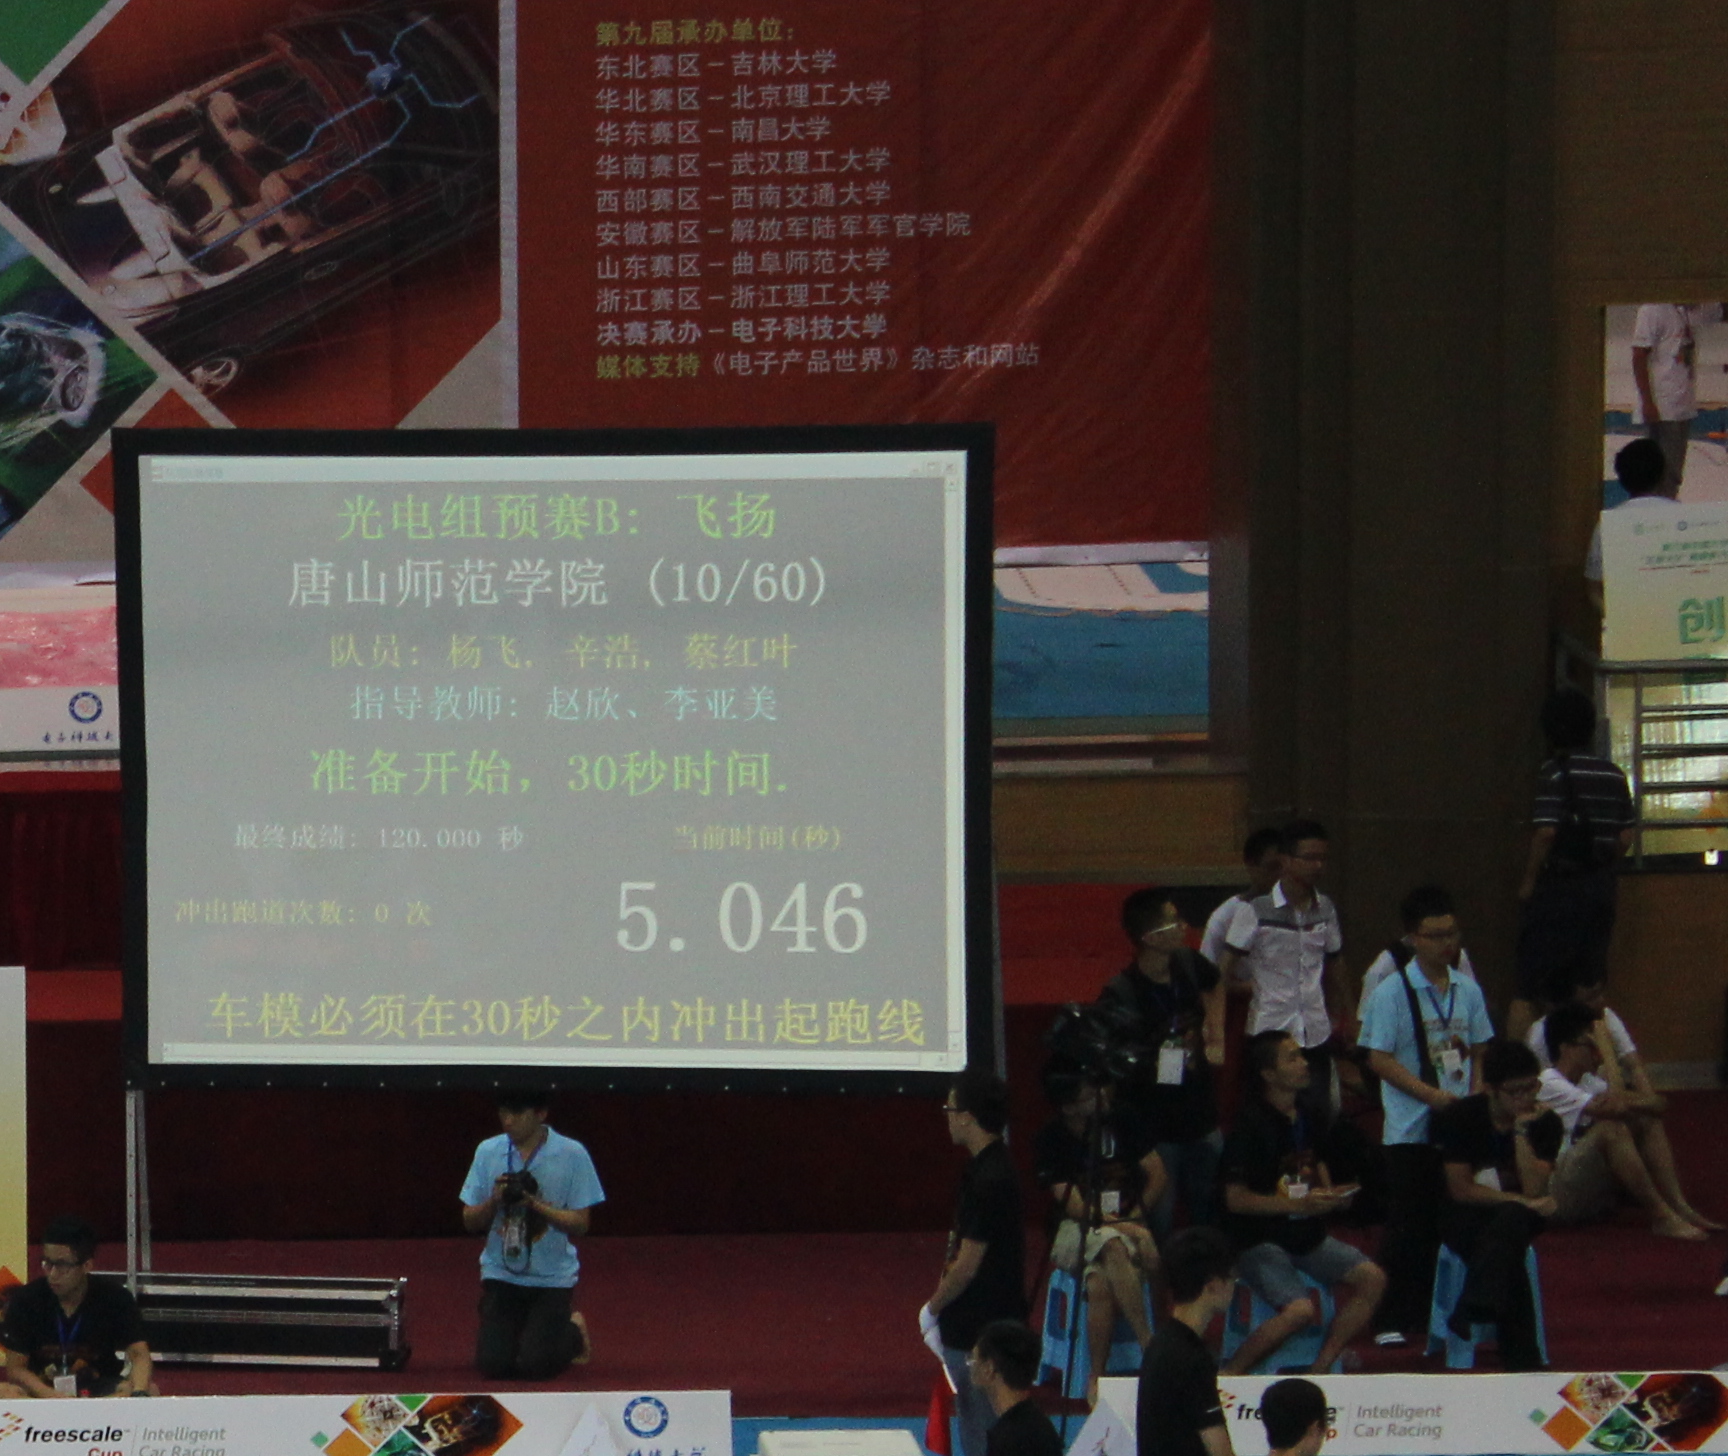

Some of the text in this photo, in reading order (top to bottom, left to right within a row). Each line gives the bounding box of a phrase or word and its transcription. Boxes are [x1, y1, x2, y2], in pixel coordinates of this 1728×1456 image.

[288, 558, 608, 610] 唐山师范学院
[616, 882, 869, 953] 5.046
[207, 993, 926, 1048] 车模必须在30秒之内冲出起跑线
[1356, 1403, 1443, 1422] Intelligent
[23, 1425, 124, 1444] freescale
[142, 1425, 226, 1446] Intelligent
[1353, 1421, 1443, 1440] Car Racing
